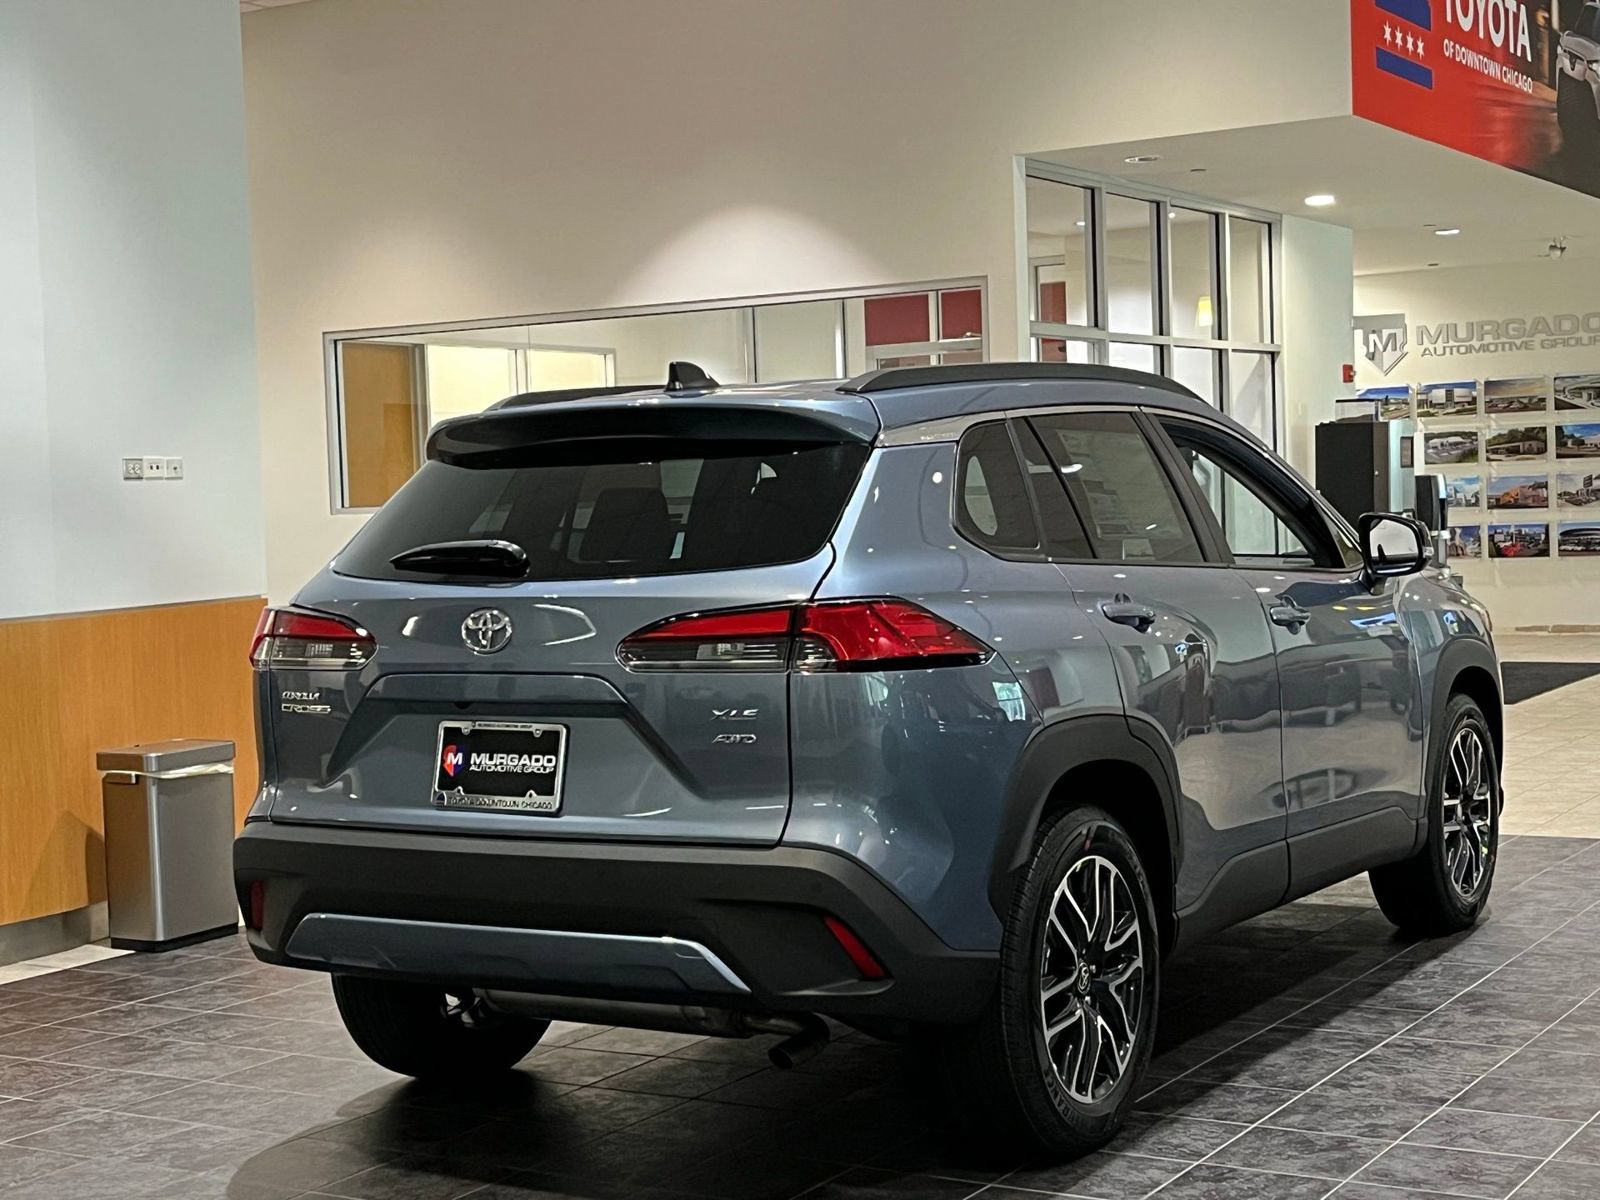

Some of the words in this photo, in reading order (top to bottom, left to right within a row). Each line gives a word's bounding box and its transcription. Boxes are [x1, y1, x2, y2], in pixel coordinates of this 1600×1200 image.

[1443, 38, 1455, 59] OF
[1455, 43, 1501, 80] DOWNTOWN
[1502, 66, 1533, 94] CHICAGO
[1416, 312, 1600, 346] MURGADO
[1421, 339, 1535, 358] AUTOMOTIVE
[1540, 334, 1600, 350] GROUP
[281, 703, 331, 714] CROSS
[710, 708, 760, 720] XLE
[470, 752, 556, 767] MURGADO
[469, 764, 522, 773] AUTOMOTIVE
[523, 765, 554, 774] GROUP
